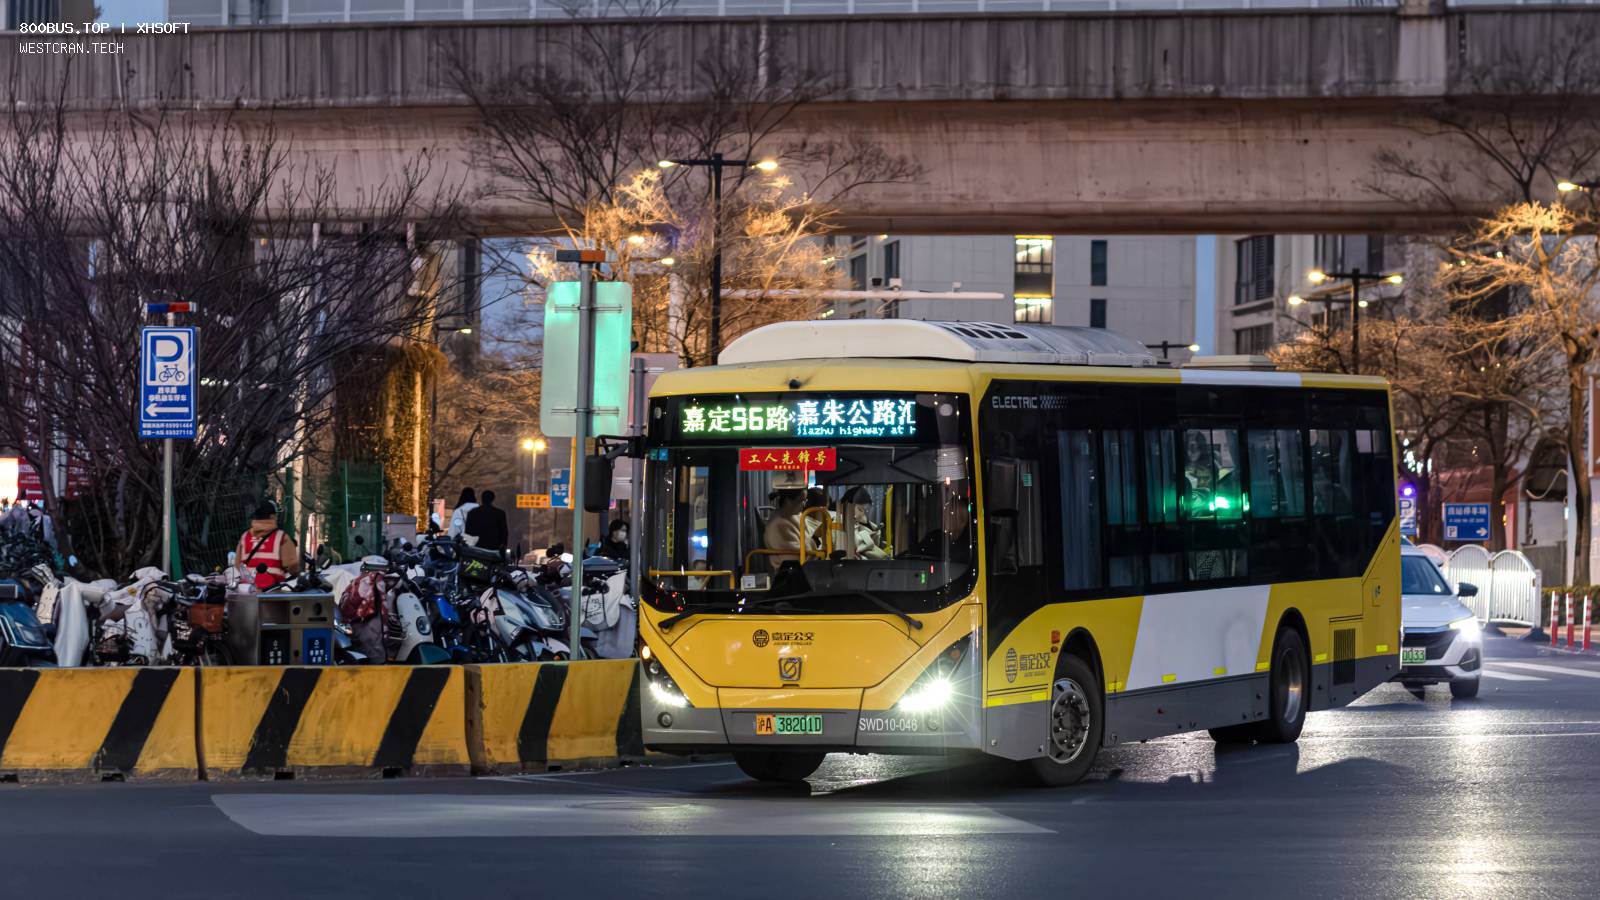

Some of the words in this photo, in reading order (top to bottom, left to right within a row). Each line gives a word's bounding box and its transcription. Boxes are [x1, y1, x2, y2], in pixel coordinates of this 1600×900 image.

[150, 335, 184, 381] P
[992, 396, 1038, 409] ELECTRIC
[682, 404, 789, 433] 嘉定96路
[796, 398, 917, 426] 嘉朱公路汇
[839, 425, 884, 437] highway
[890, 425, 905, 435] at
[778, 716, 822, 732] 38201D
[858, 717, 918, 732] SWD10-046
